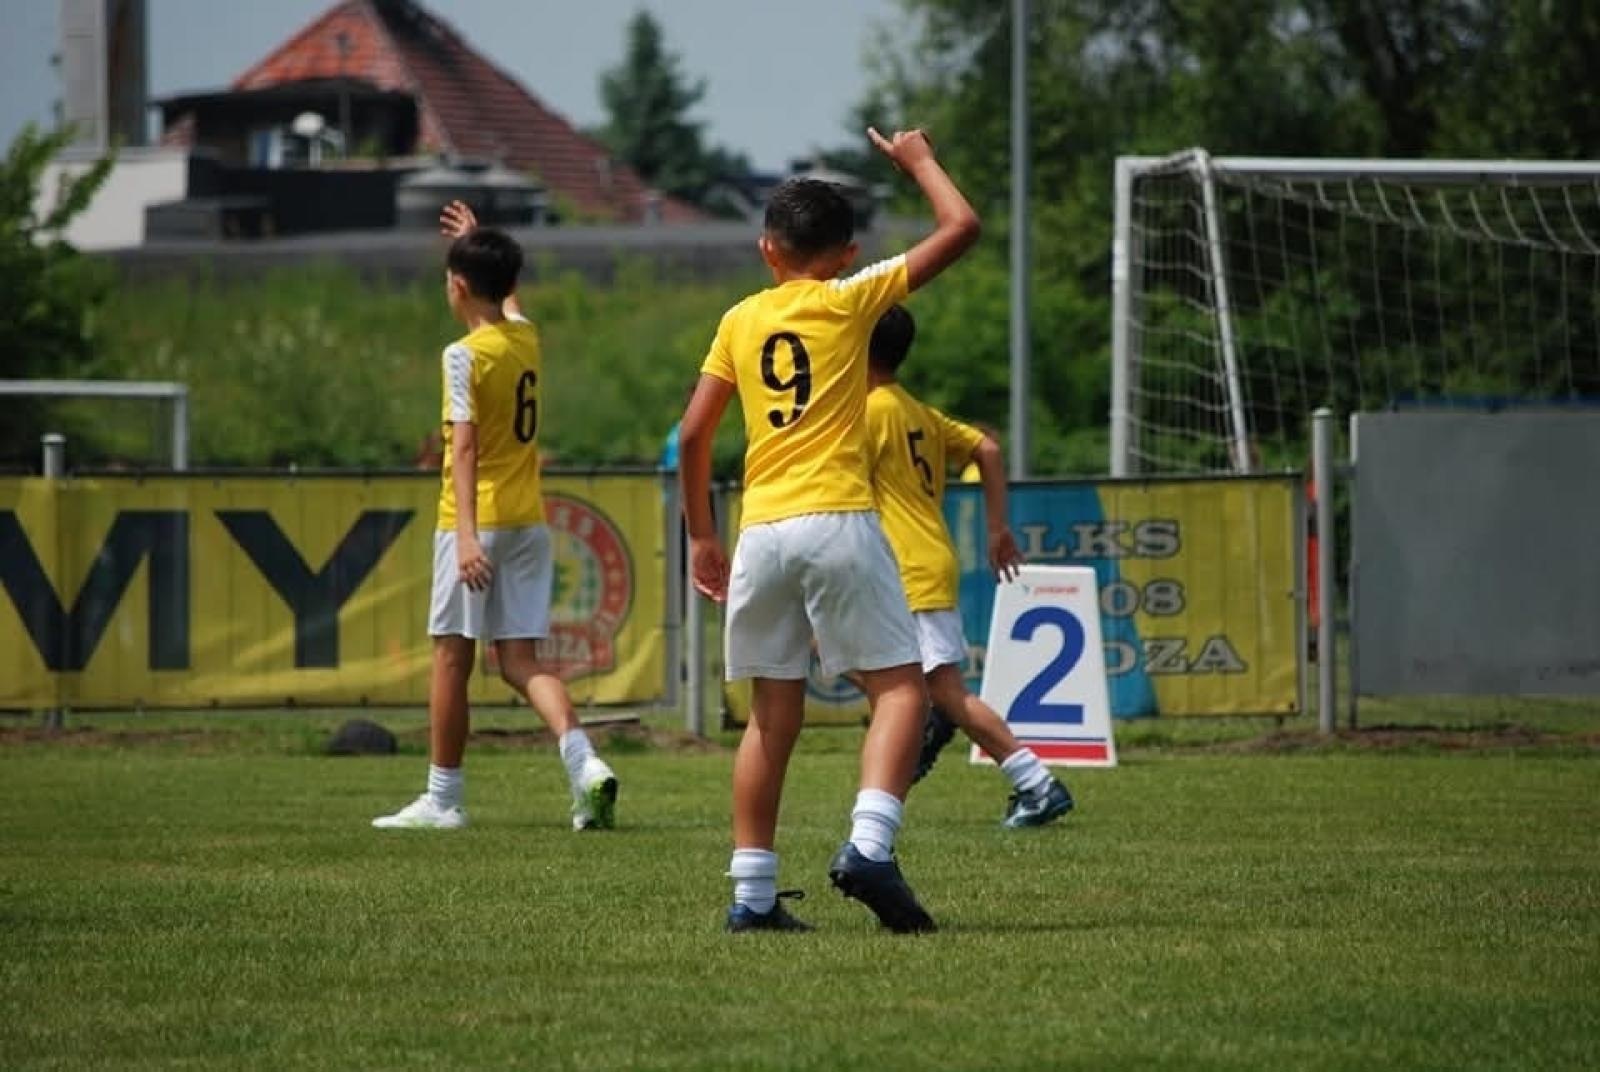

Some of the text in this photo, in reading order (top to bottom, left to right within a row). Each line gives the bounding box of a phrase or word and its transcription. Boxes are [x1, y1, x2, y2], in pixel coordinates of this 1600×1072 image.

[514, 369, 537, 444] 6
[760, 331, 811, 429] 9
[907, 427, 935, 498] 5
[1021, 520, 1181, 558] LKS
[1101, 578, 1186, 616] 08
[1006, 606, 1086, 725] 2
